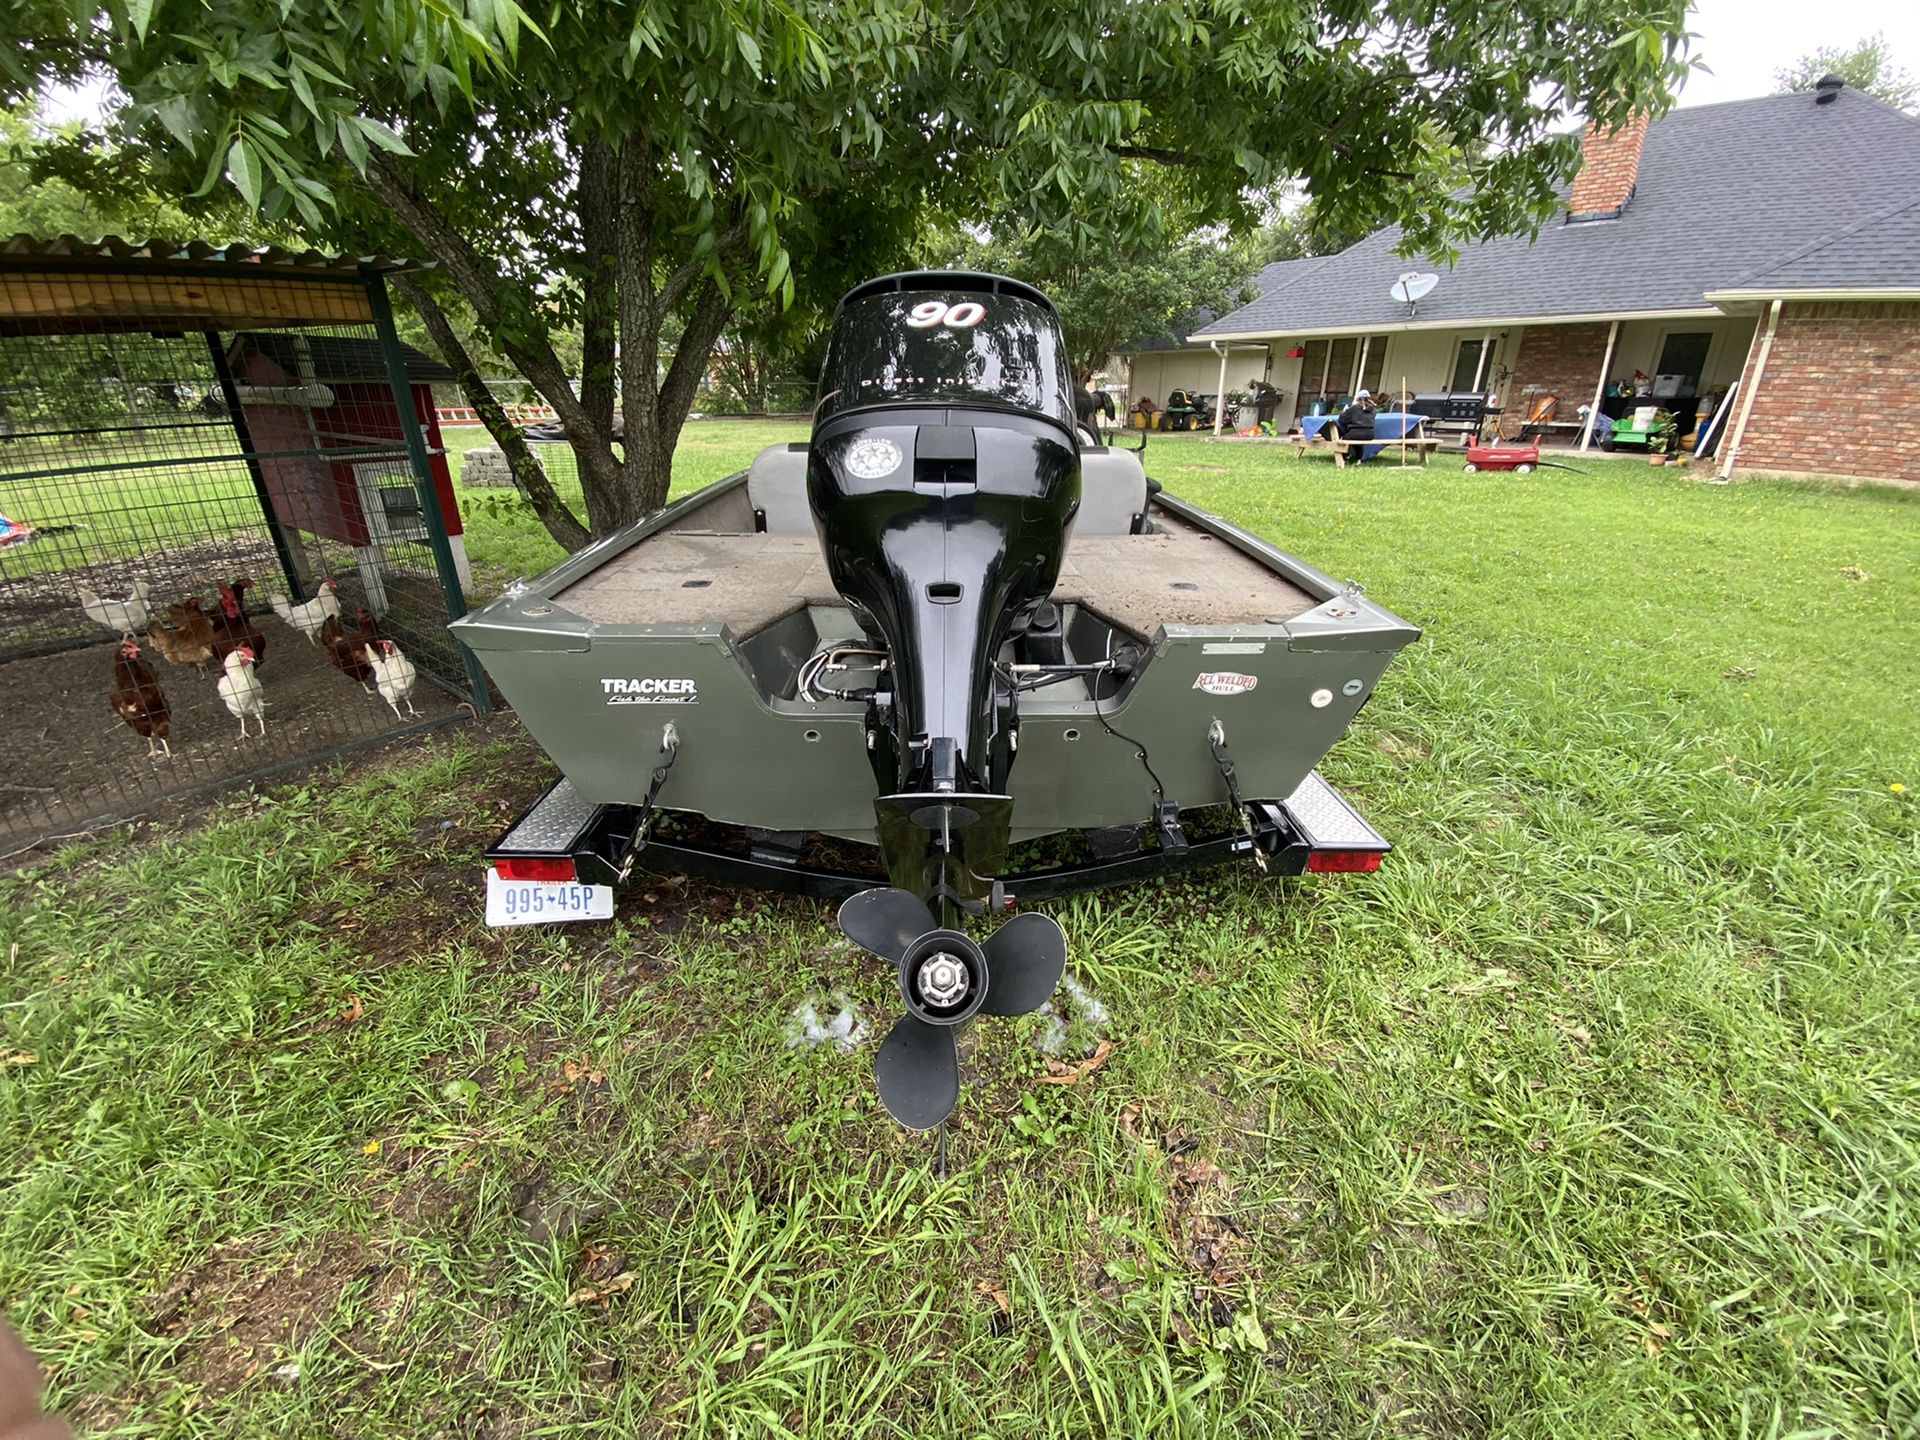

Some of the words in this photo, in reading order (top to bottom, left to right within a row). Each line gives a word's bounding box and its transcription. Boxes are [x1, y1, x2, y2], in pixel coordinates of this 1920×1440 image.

[906, 301, 986, 328] 90
[600, 678, 696, 693] TRACKER
[1217, 675, 1256, 689] WELDED
